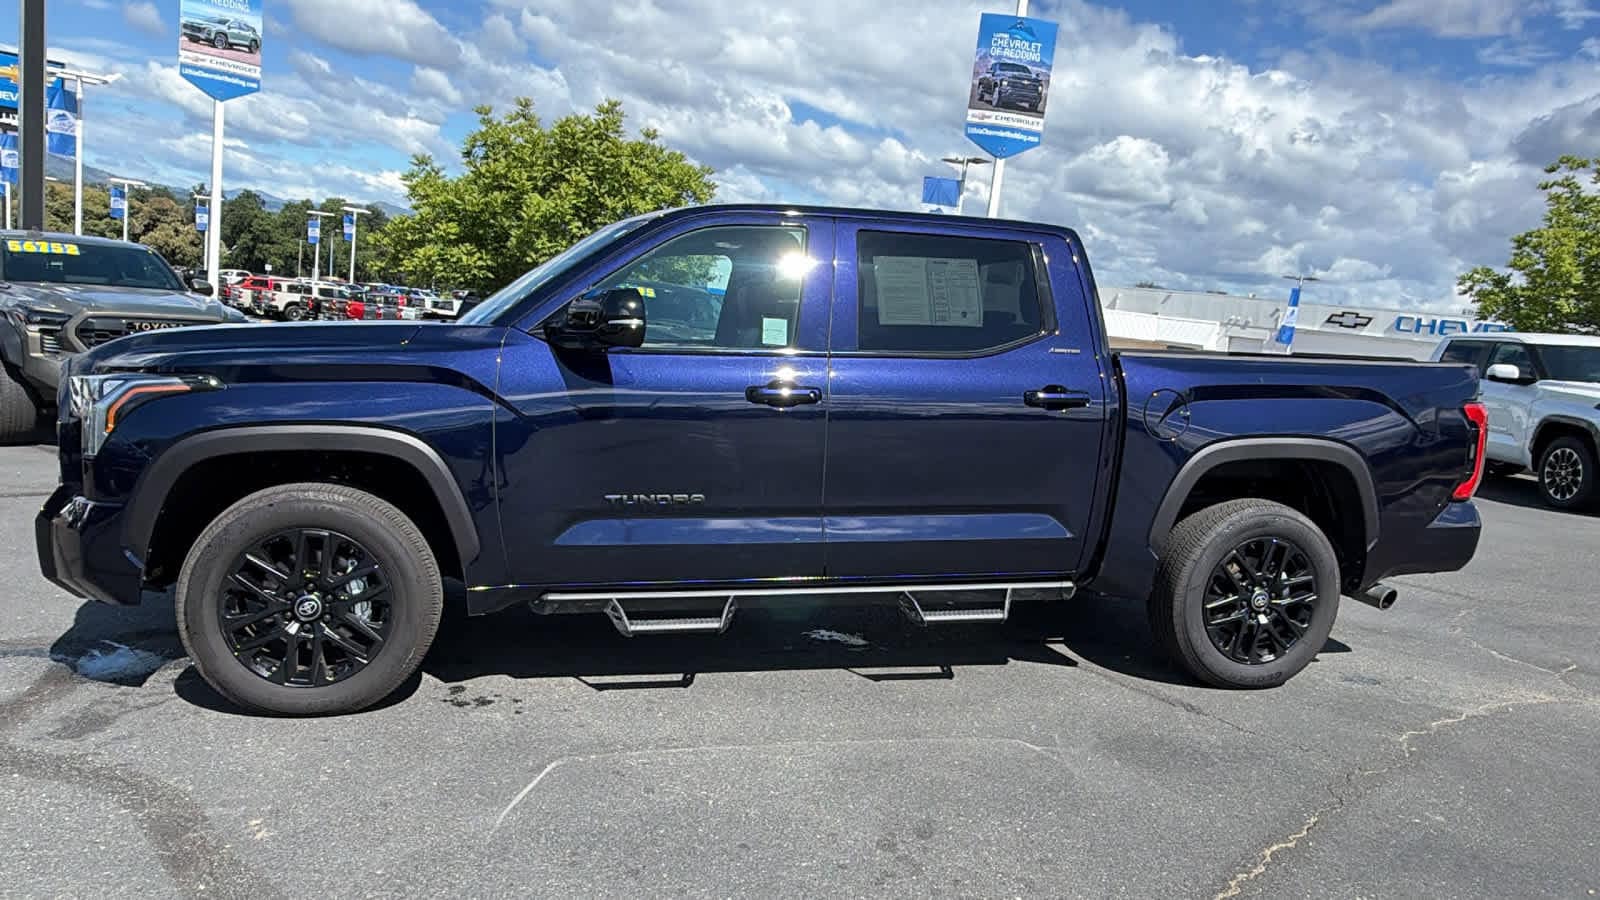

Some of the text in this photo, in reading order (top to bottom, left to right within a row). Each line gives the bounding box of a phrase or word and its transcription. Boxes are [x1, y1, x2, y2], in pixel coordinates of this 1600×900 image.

[991, 38, 1042, 53] CHEVROLET
[990, 46, 1041, 62] OF REDDING
[209, 58, 257, 74] CHEVROLET
[994, 114, 1040, 127] CHEVROLET
[7, 240, 80, 255] 56752
[604, 494, 705, 505] TUNDRA
